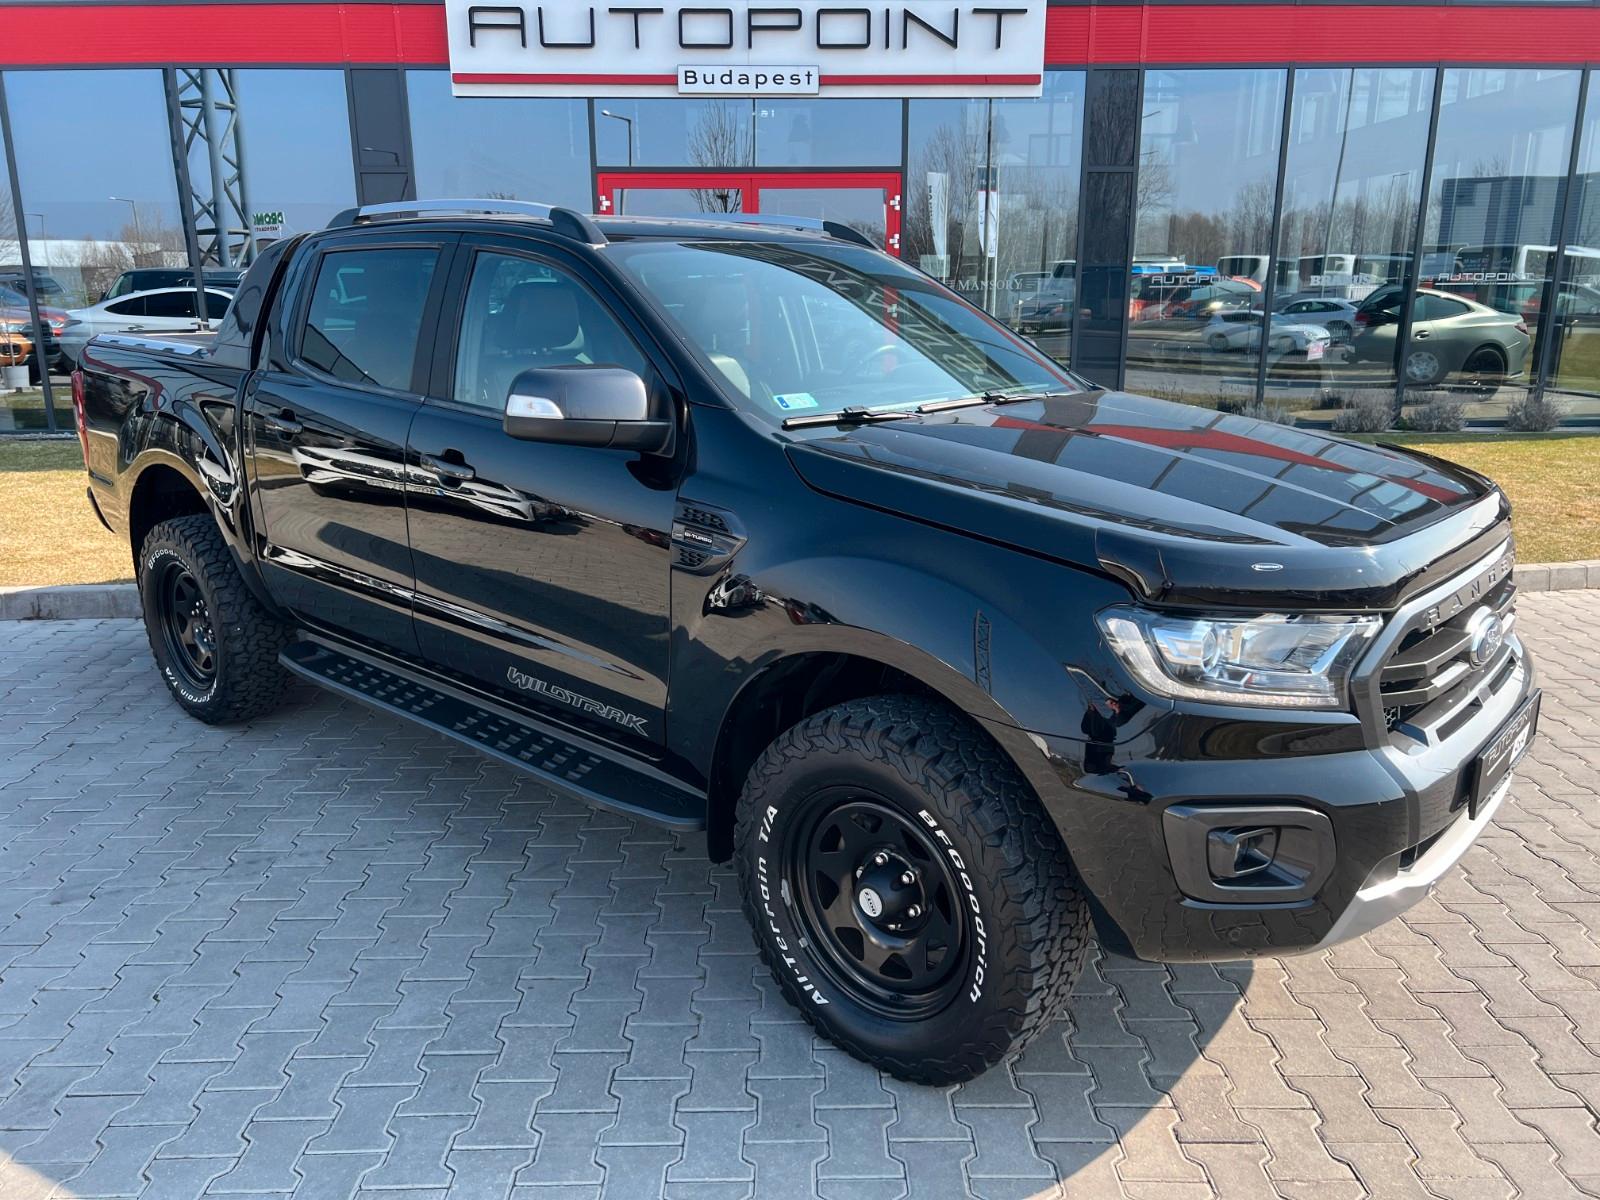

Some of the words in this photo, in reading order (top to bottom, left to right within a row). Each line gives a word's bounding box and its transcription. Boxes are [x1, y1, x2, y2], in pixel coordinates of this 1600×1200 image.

[468, 6, 1028, 50] AUTOPOINT
[684, 69, 814, 89] Budapest
[958, 279, 1023, 291] MANSORY
[1438, 272, 1535, 281] AUTOPOINT
[1424, 550, 1515, 626] RANGE
[506, 665, 649, 737] WILDTRAK
[758, 804, 779, 844] T/A
[917, 809, 987, 1004] BFGoodrich
[756, 856, 830, 1006] All-Terrain
